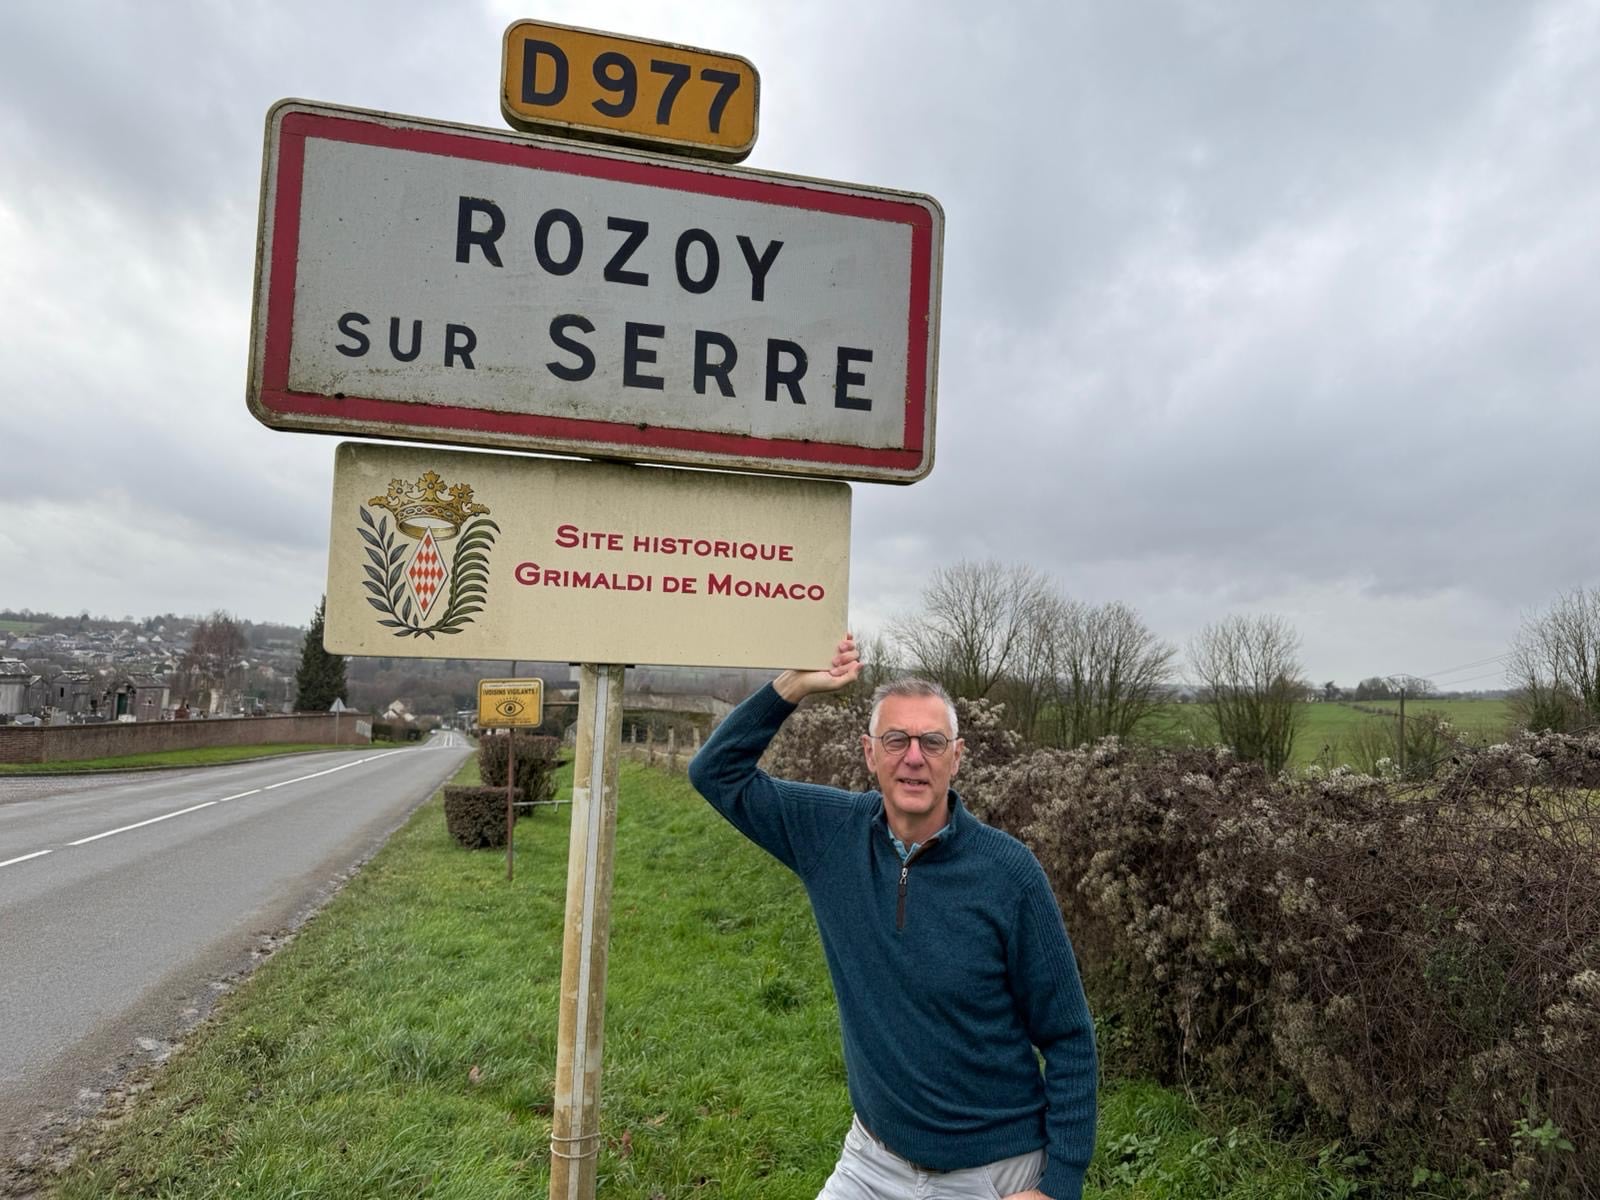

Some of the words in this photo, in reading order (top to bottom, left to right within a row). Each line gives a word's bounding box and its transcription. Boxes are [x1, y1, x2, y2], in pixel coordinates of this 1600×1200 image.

[520, 37, 570, 107] D
[591, 51, 742, 135] 977
[455, 195, 785, 303] ROZOY
[335, 311, 478, 371] SUR
[545, 313, 874, 412] SERRE
